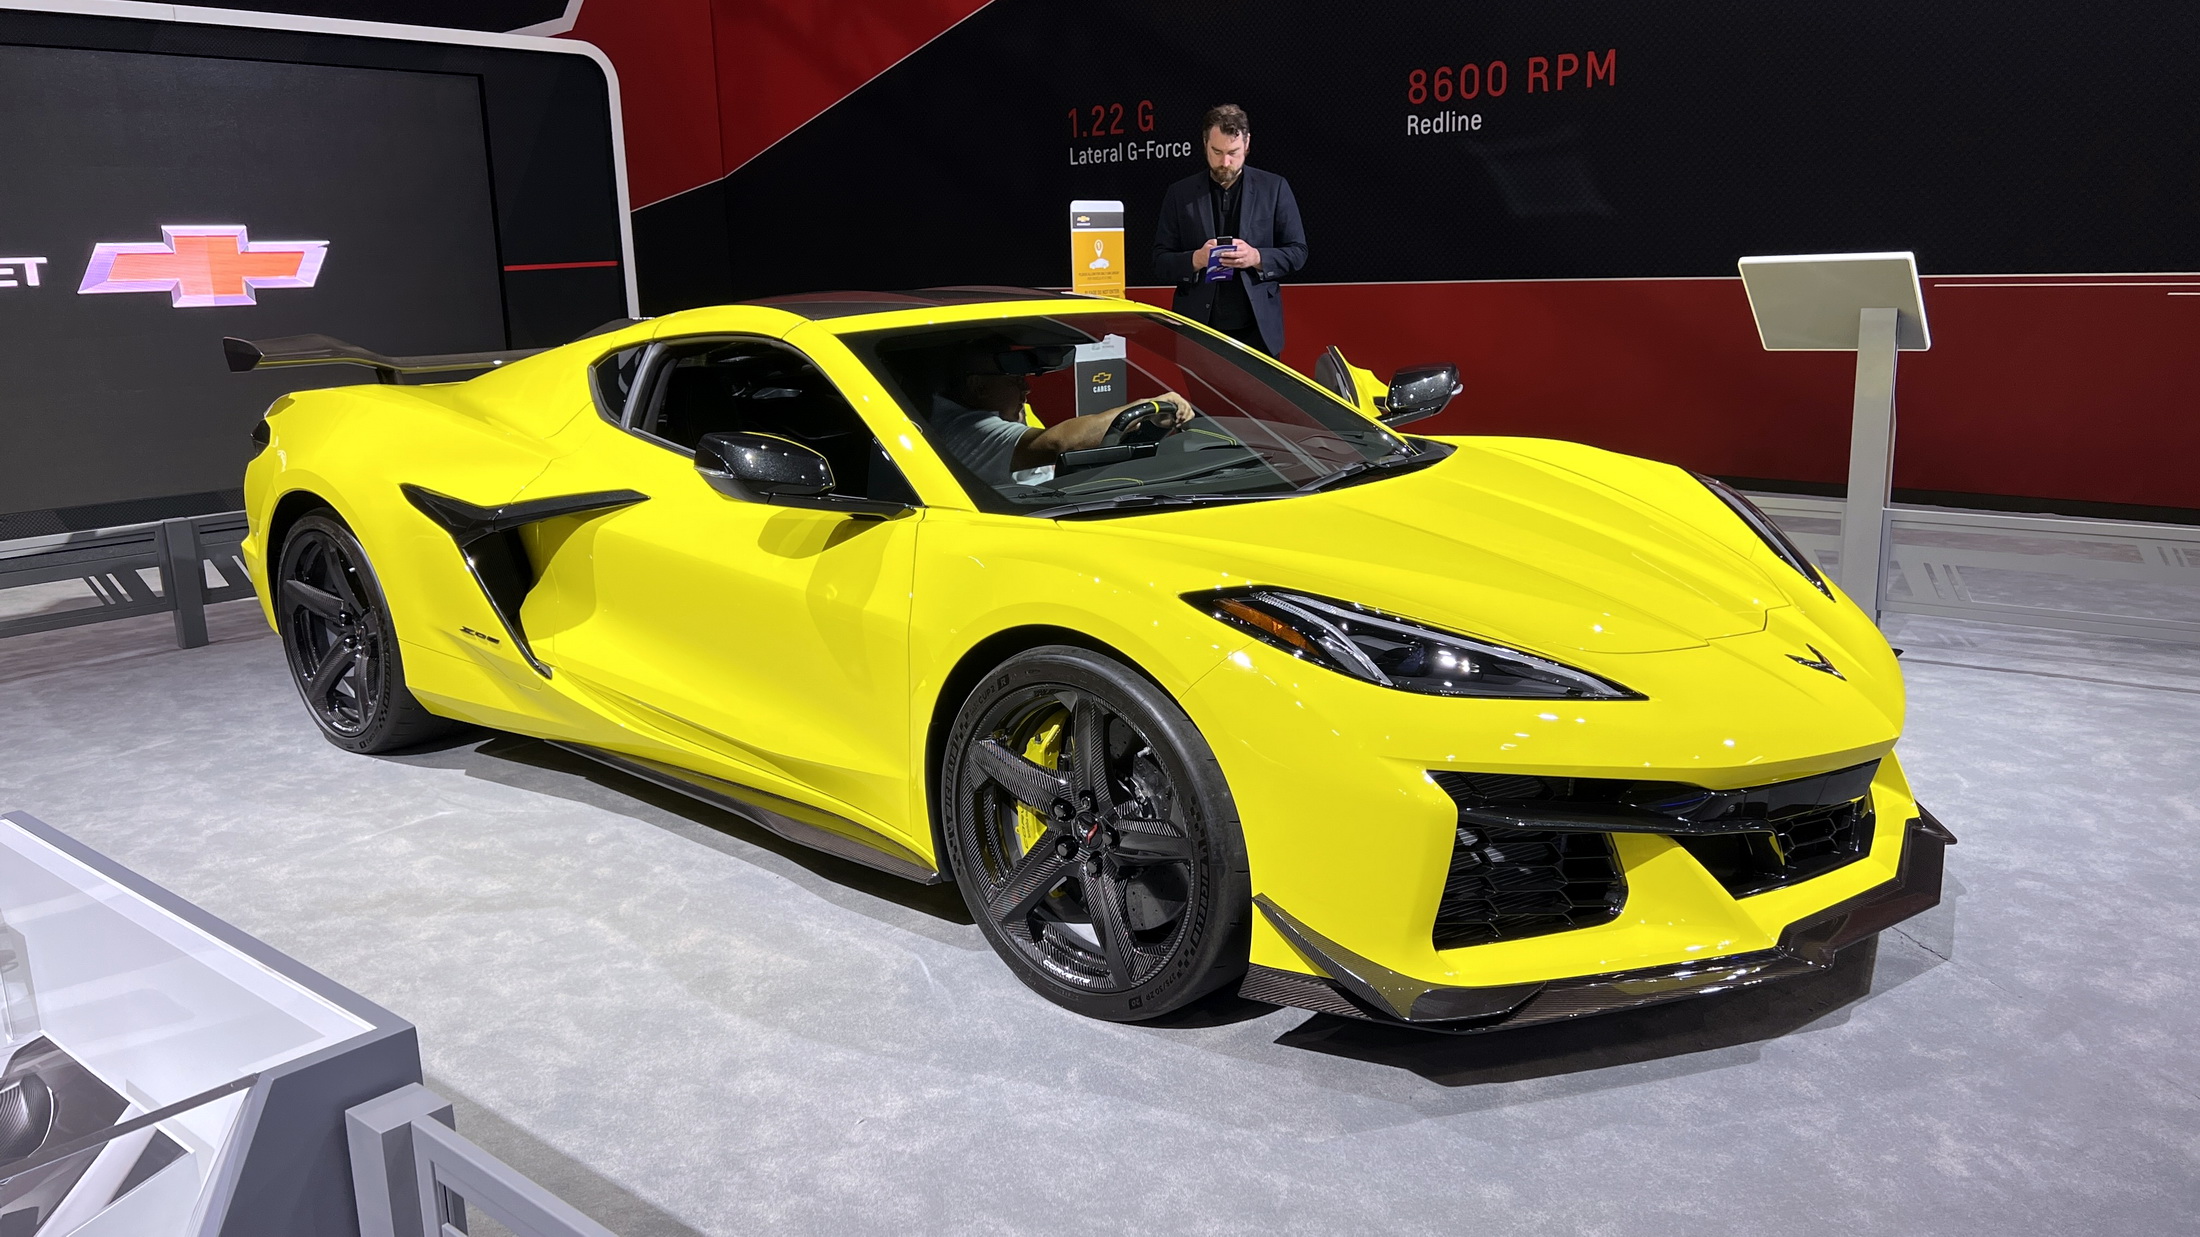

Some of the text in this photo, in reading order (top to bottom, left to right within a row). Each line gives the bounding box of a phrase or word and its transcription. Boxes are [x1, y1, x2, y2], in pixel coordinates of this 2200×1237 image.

[1408, 48, 1616, 105] 8600 RPM
[1068, 99, 1155, 139] 1.22 G
[1407, 110, 1483, 136] Redline
[1069, 140, 1192, 166] Lateral G-Force
[945, 745, 959, 819] MICHELIN
[1192, 863, 1210, 942] MICHELIN
